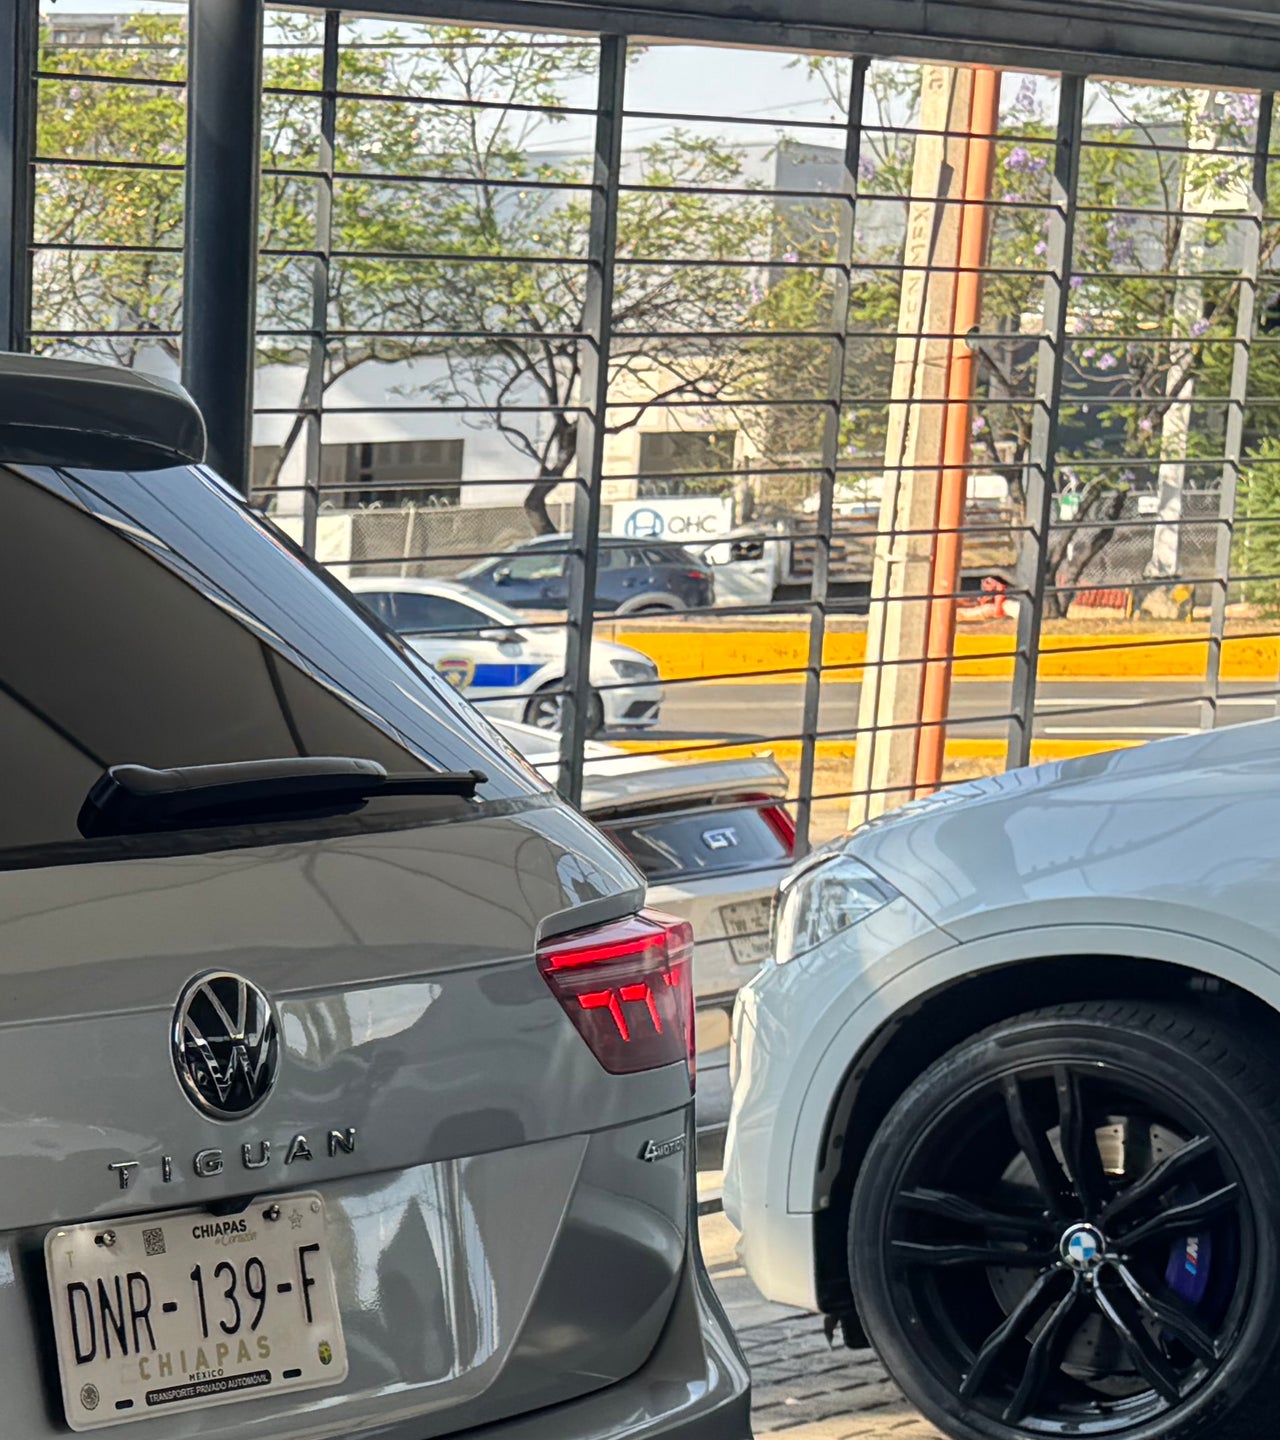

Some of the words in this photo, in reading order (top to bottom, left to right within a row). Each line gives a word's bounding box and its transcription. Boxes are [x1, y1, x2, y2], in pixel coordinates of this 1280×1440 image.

[702, 827, 738, 850] GT
[108, 1128, 357, 1189] TIGUAN
[192, 1219, 247, 1240] CHIAPAS
[67, 1243, 320, 1365] DNR-139-F
[138, 1335, 271, 1381] CHIAPAS
[149, 1387, 196, 1403] TRANSPORTE
[196, 1382, 227, 1394] PRIVADO
